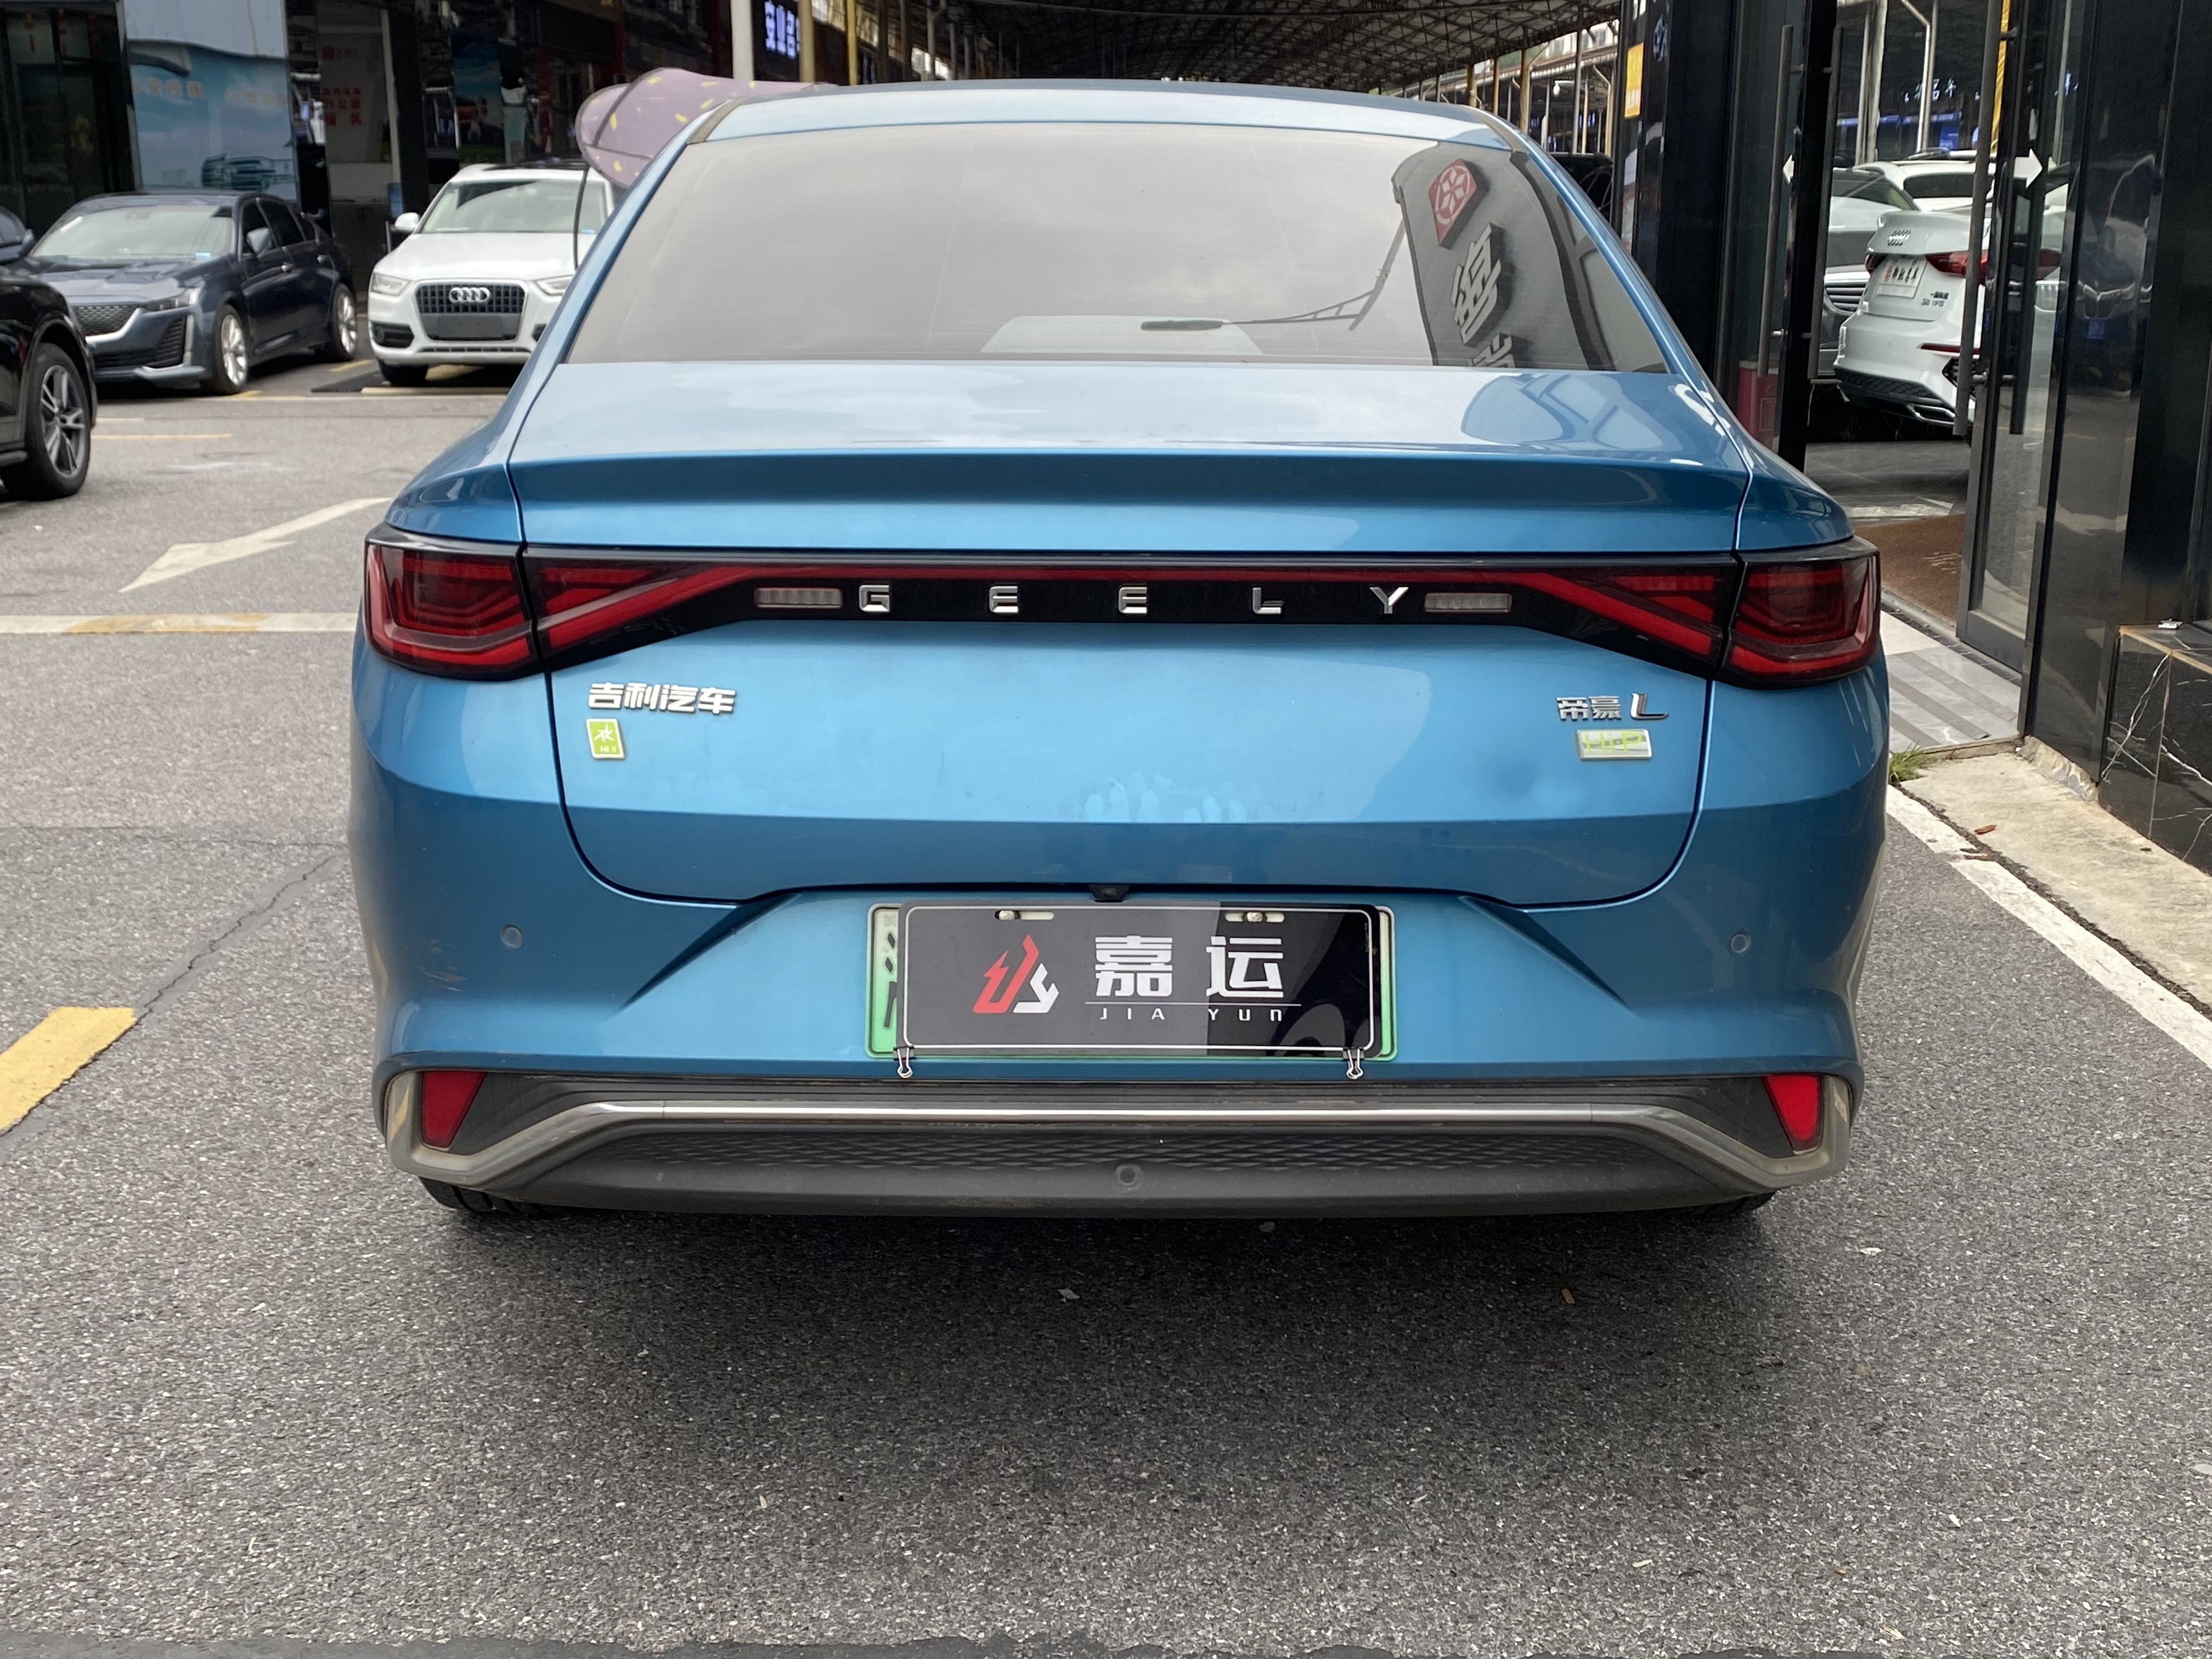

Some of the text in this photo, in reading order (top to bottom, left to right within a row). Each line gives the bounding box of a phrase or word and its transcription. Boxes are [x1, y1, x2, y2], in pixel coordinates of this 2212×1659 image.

[859, 584, 1409, 616] GEELY
[588, 682, 737, 715] 吉利汽车
[1556, 692, 1669, 721] 帝豪 L
[1094, 935, 1284, 1000] 嘉运
[1099, 1007, 1283, 1022] JIA YUN
